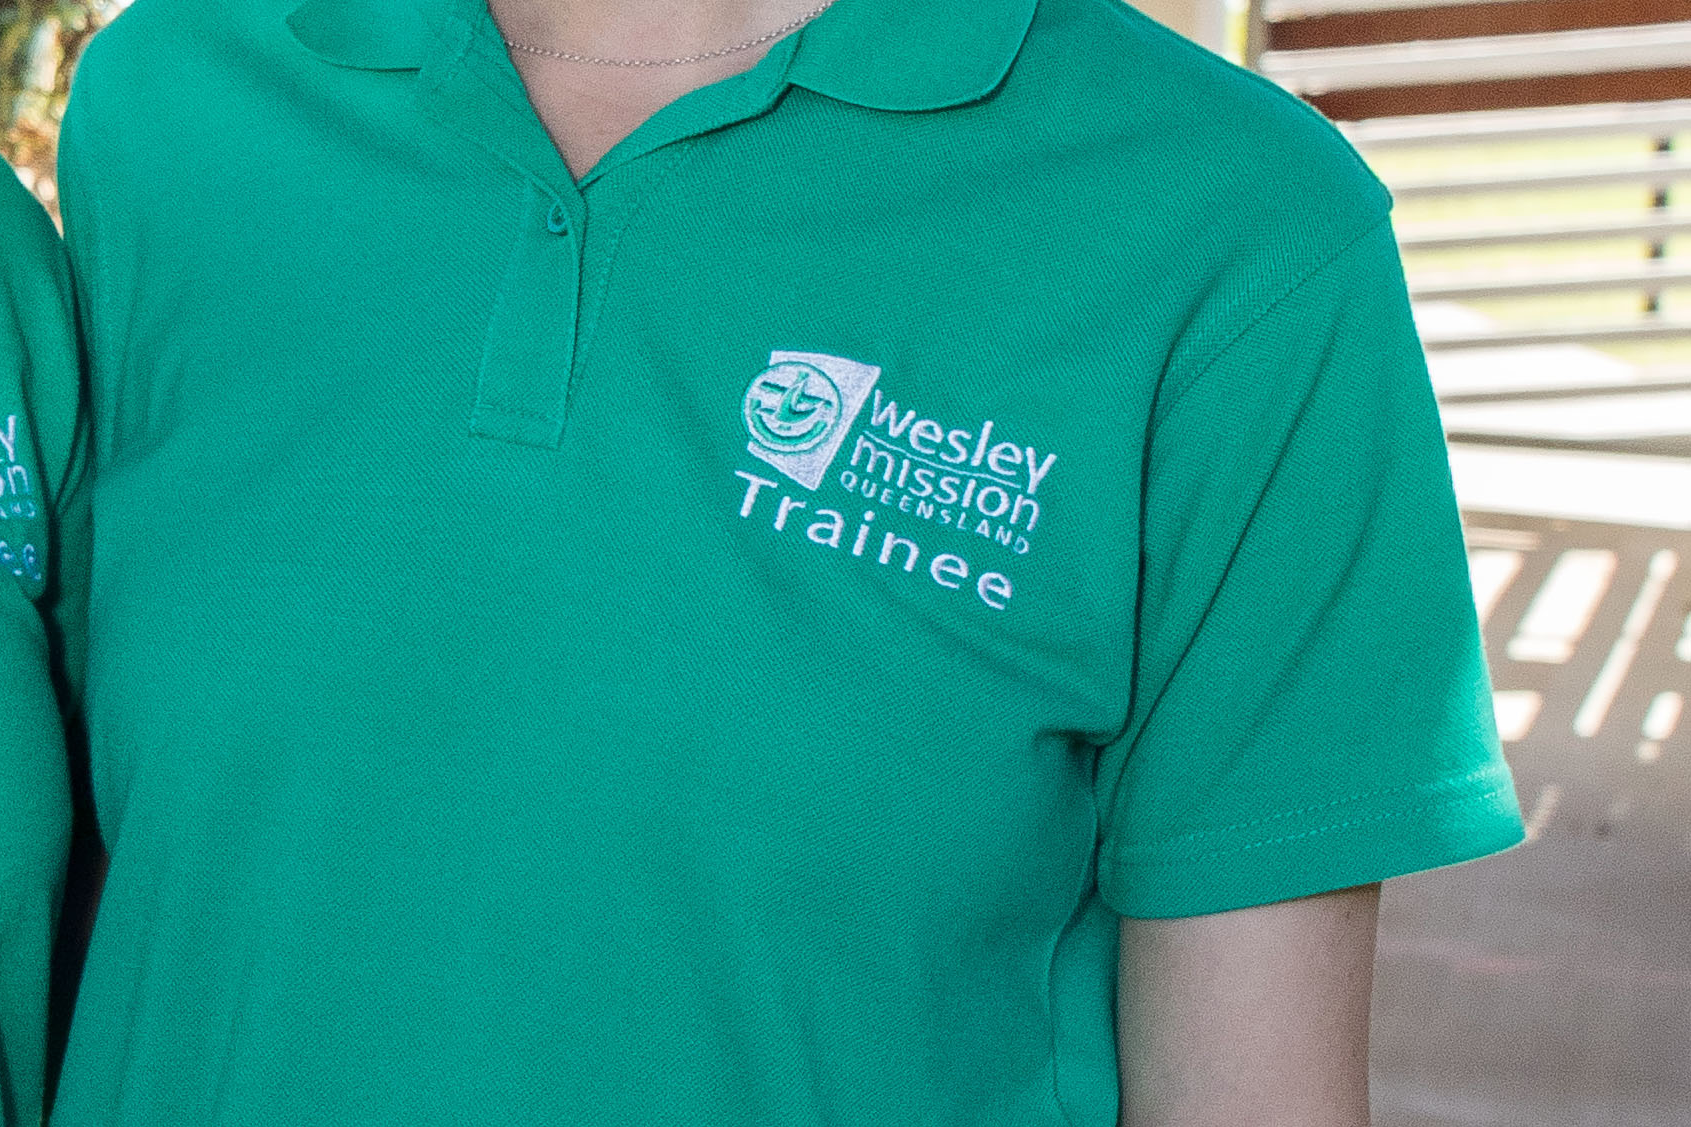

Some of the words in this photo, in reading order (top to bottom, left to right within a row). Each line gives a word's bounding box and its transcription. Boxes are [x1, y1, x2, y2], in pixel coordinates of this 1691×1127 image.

[850, 435, 1040, 532] mission
[871, 389, 1057, 494] wesley
[734, 469, 1013, 610] Trainee
[840, 470, 1030, 554] QUEENSLAND
